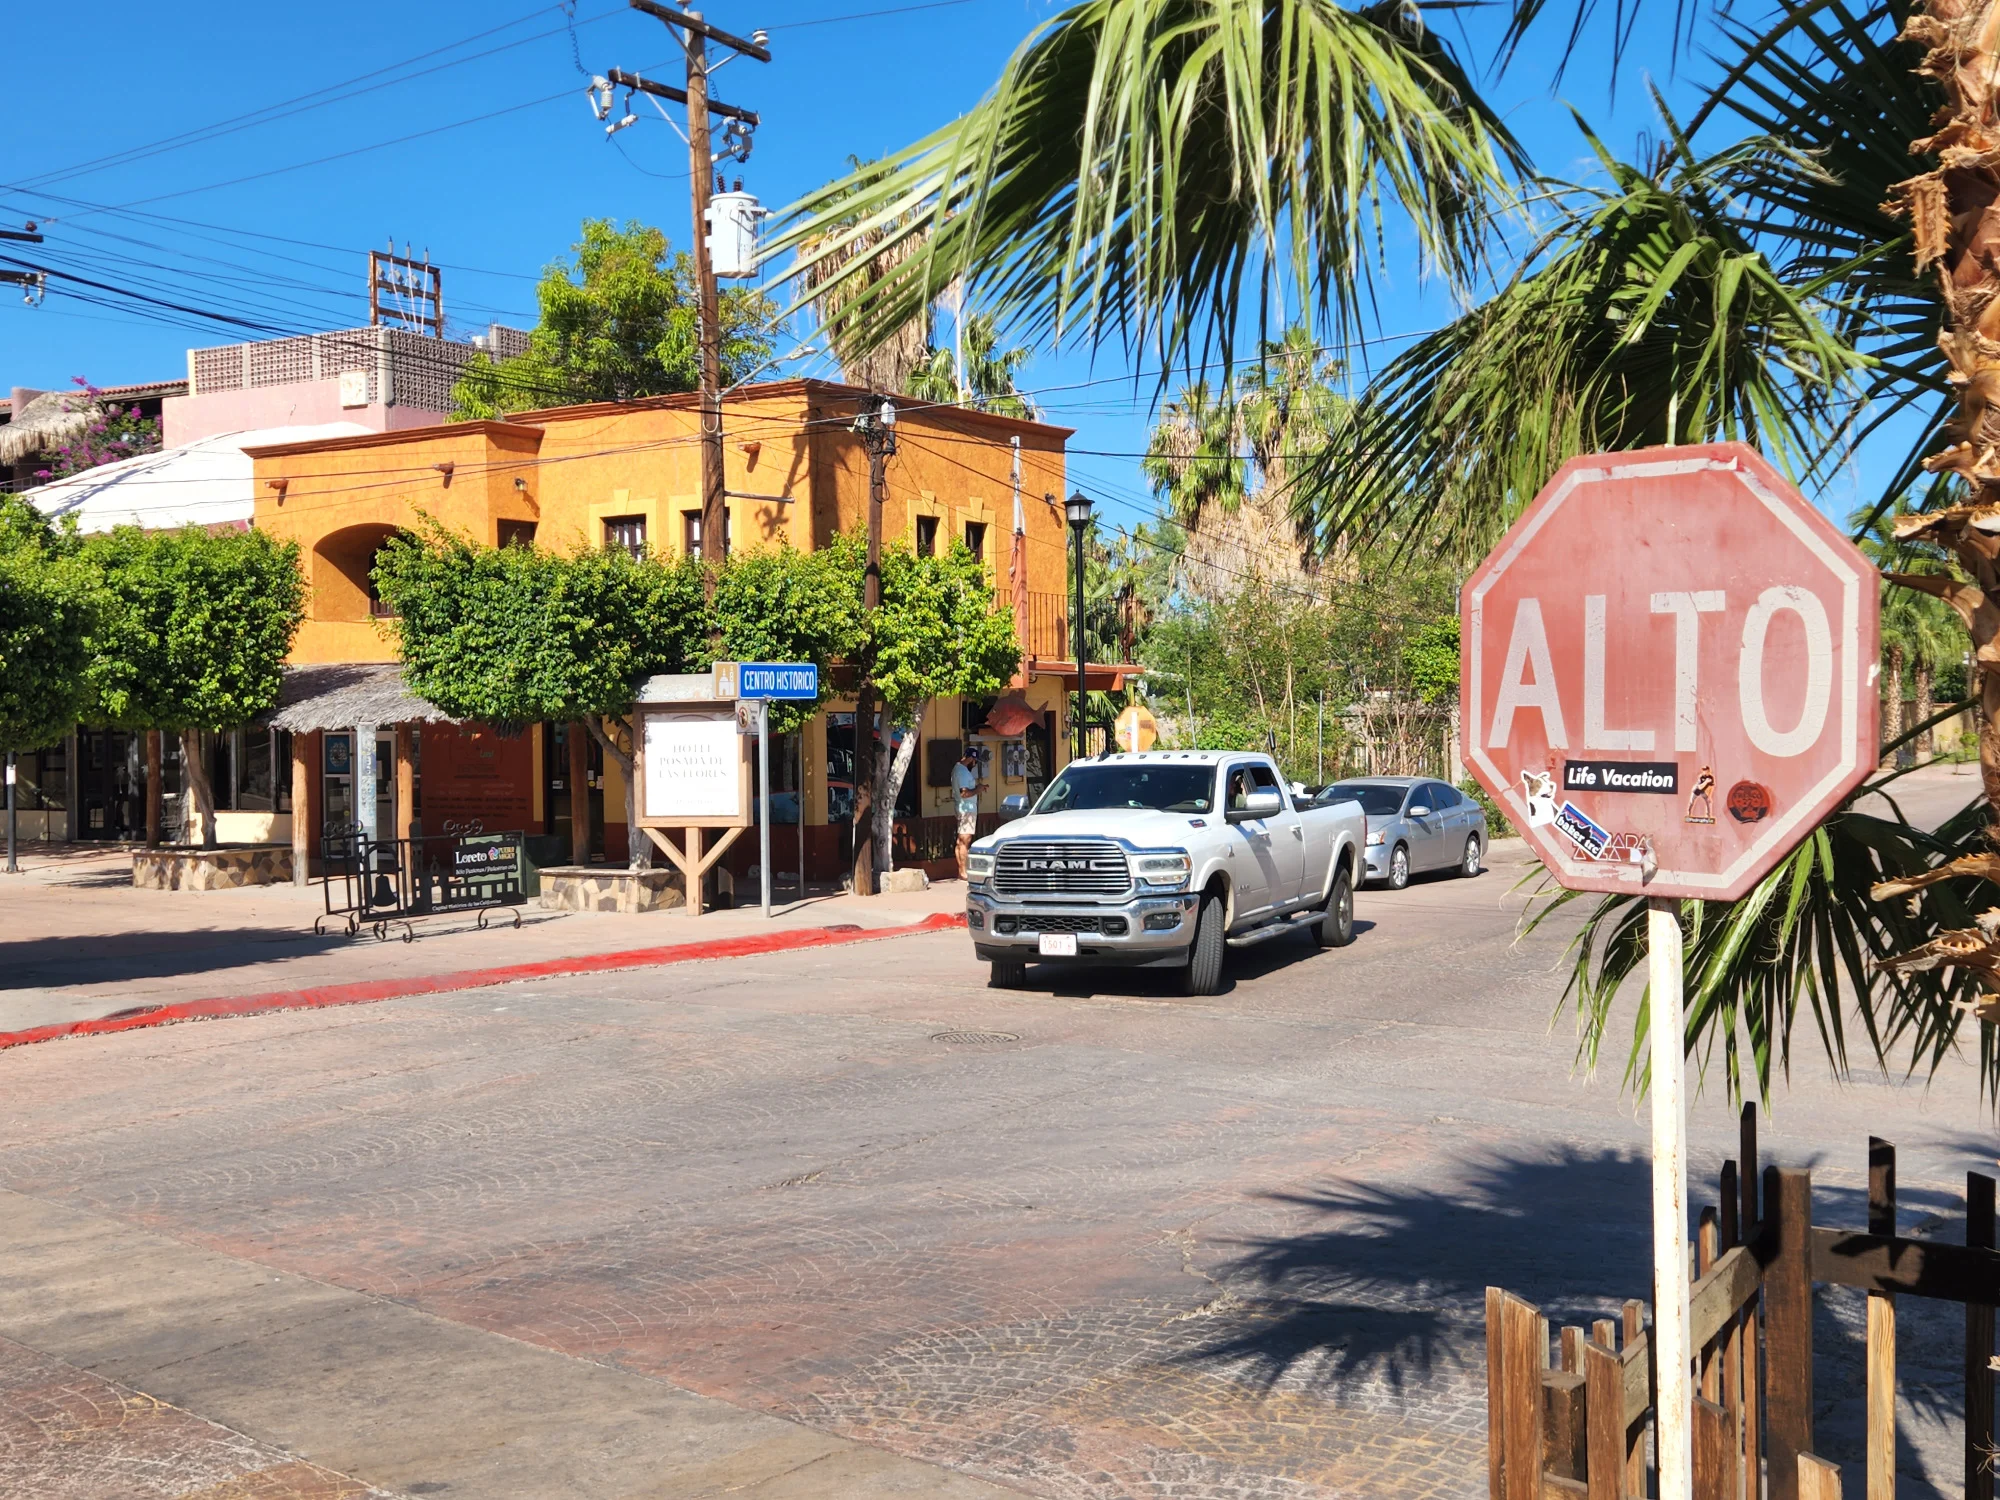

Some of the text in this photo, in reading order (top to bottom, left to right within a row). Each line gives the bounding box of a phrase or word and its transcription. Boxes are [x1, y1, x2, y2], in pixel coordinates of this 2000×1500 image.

[744, 670, 815, 691] CENTRO HISTORICO
[1487, 585, 1832, 757] ALTO
[1567, 766, 1674, 788] Life Vacation
[1557, 816, 1585, 842] baker
[455, 851, 487, 864] Loreto
[1030, 861, 1086, 869] RAM
